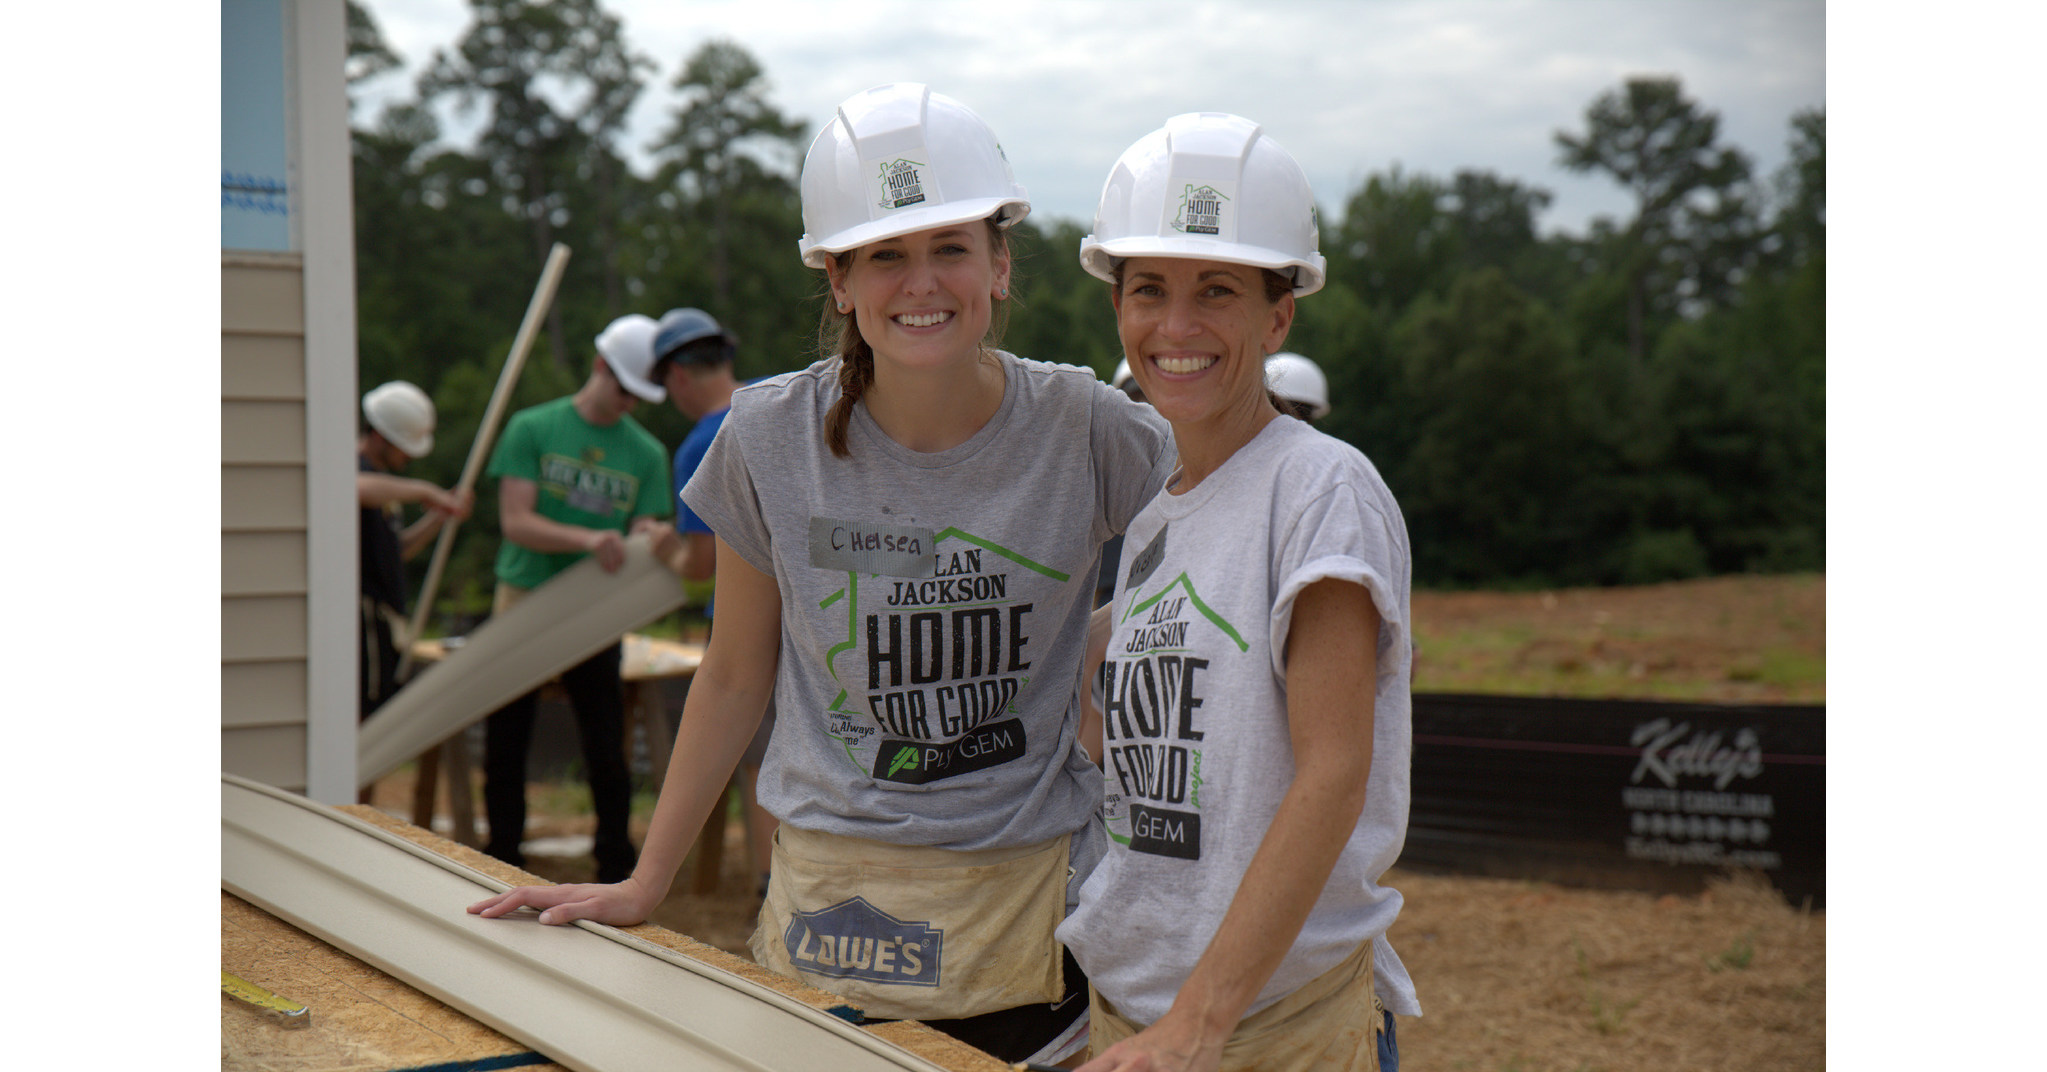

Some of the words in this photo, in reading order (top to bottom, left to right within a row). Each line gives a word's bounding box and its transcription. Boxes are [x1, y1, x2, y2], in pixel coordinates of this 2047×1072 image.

[888, 169, 920, 190] HOME
[891, 189, 903, 200] FOR
[903, 184, 920, 196] GOOD
[1187, 199, 1221, 215] HOME
[1187, 214, 1198, 224] FOR
[1200, 215, 1217, 225] GOOD
[934, 549, 982, 577] LAN
[887, 574, 1006, 606] JACKSON
[866, 603, 1033, 690] HOME
[867, 689, 932, 740] FOR
[936, 677, 1018, 738] GOOD
[960, 729, 1014, 758] GEM
[1630, 716, 1764, 790] Kelly's
[1189, 749, 1204, 809] project
[1135, 811, 1185, 844] GEM
[796, 925, 923, 976] LOWE'S
